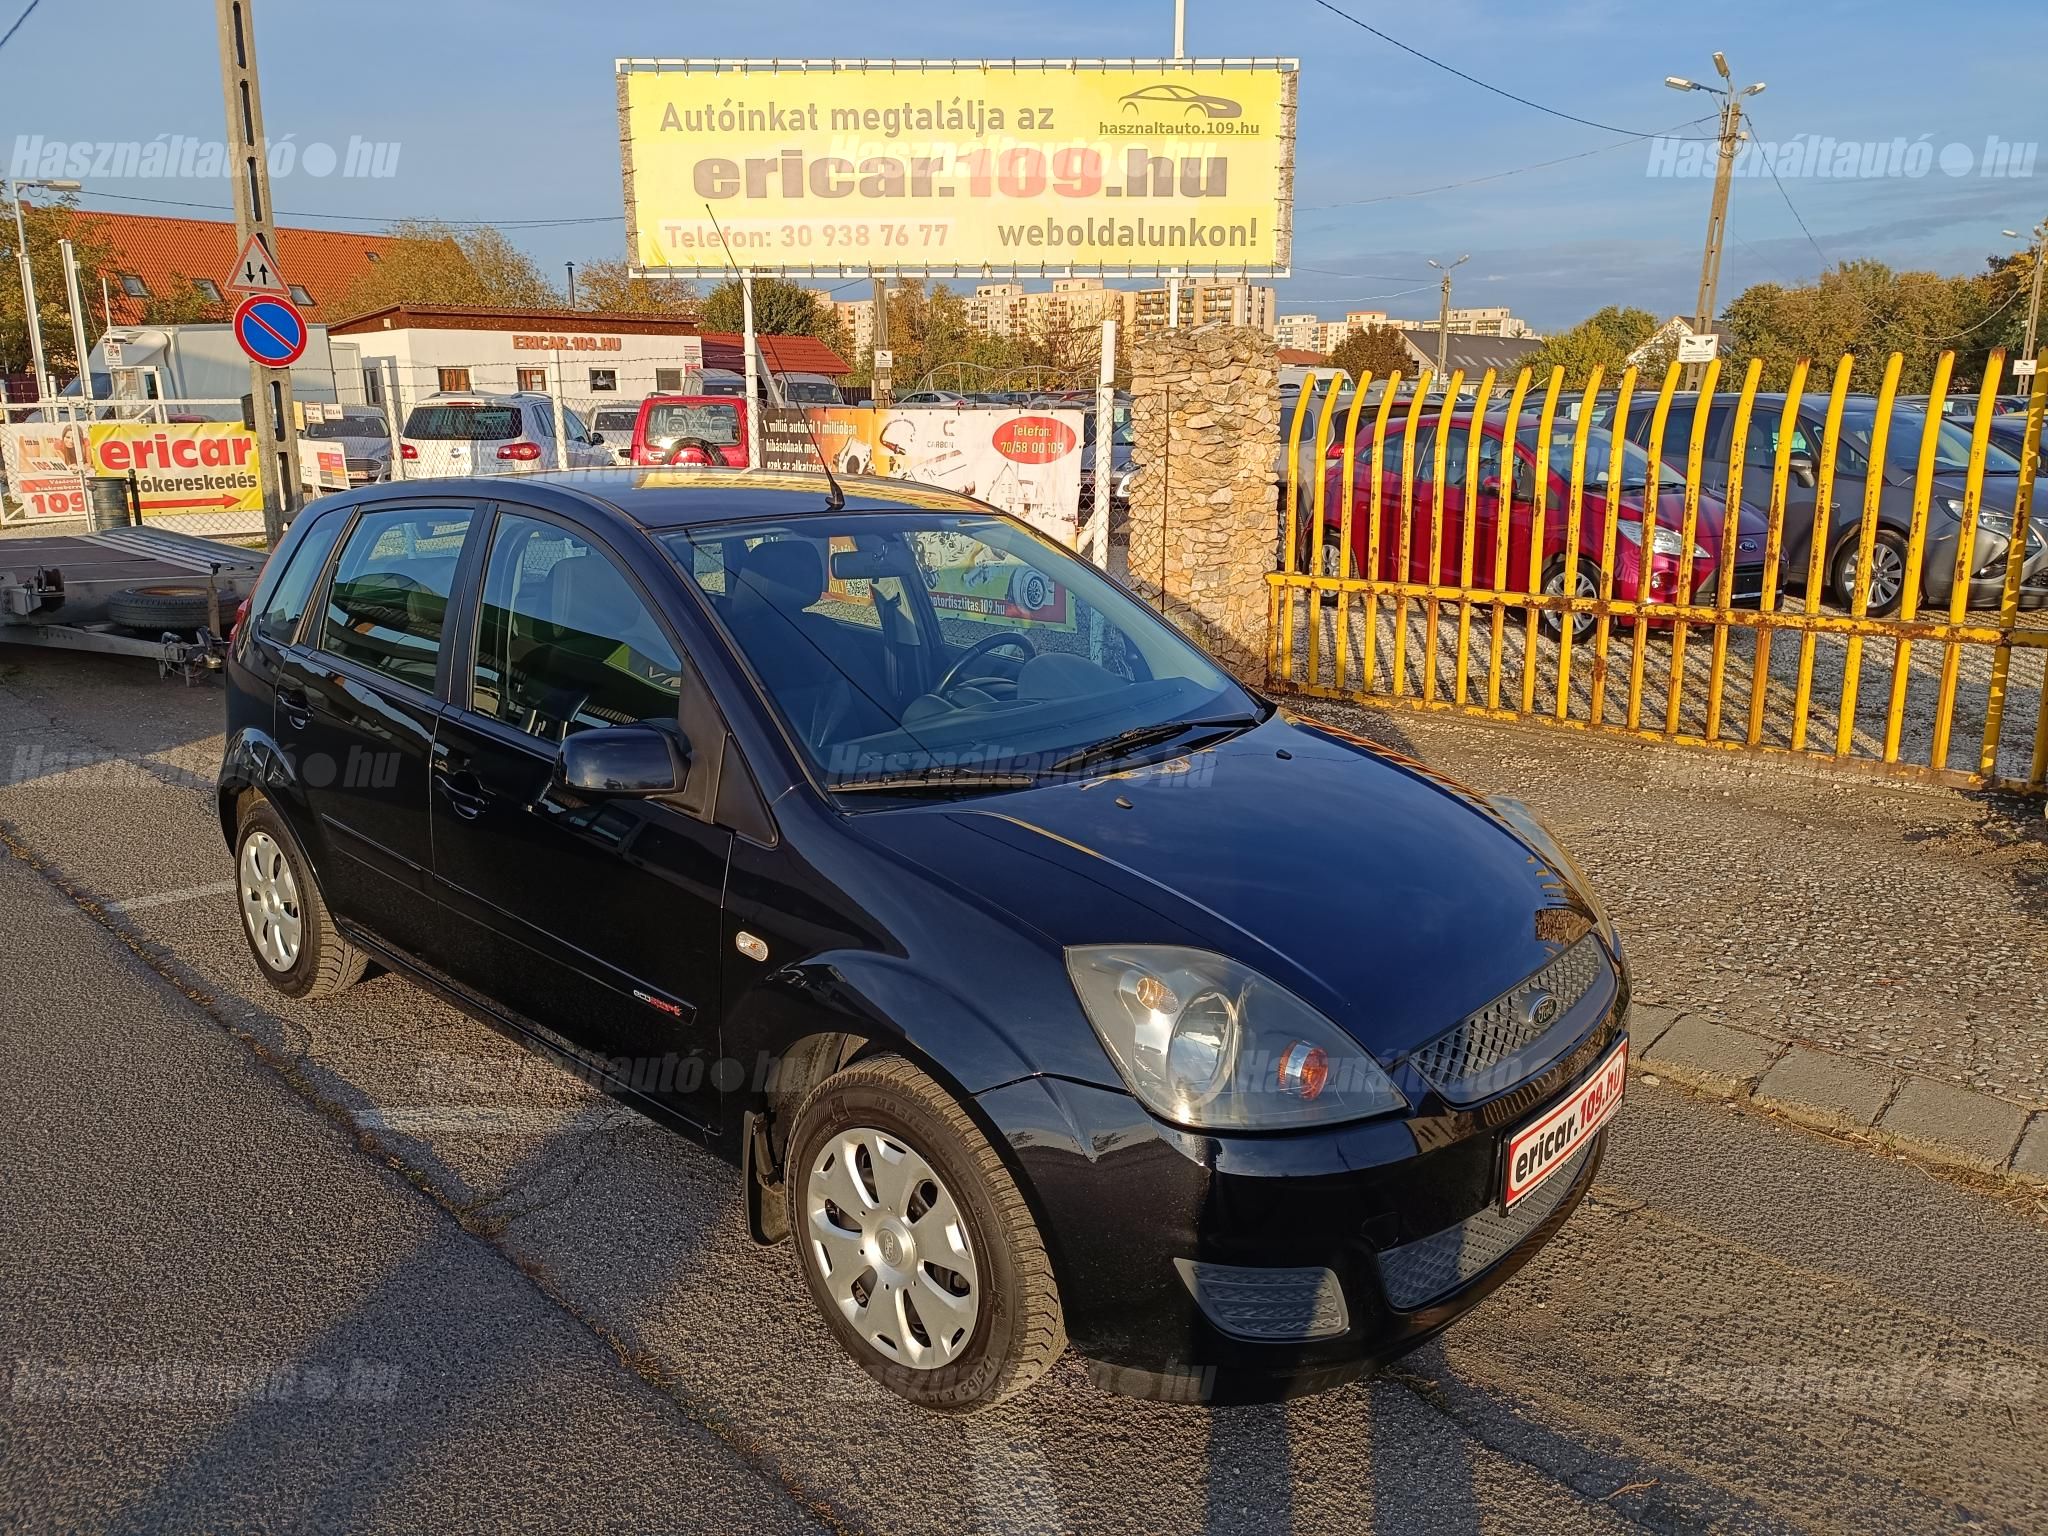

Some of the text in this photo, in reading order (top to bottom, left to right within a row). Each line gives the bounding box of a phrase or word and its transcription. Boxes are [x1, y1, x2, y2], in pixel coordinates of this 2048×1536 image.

[660, 97, 1054, 138] Autóinkat megtalálja az
[1099, 121, 1260, 135] hasznaltauto.109.hu
[693, 147, 1228, 199] ericar.109.hu
[664, 224, 949, 248] Telefon: 30 938 76 77
[998, 217, 1257, 247] weboldalunkon!
[512, 335, 623, 351] ERICAR.109.HU
[100, 434, 252, 470] ericar
[1001, 441, 1028, 453] 70/58
[1047, 442, 1064, 453] 109
[1515, 1061, 1622, 1184] ericar.109.hu
